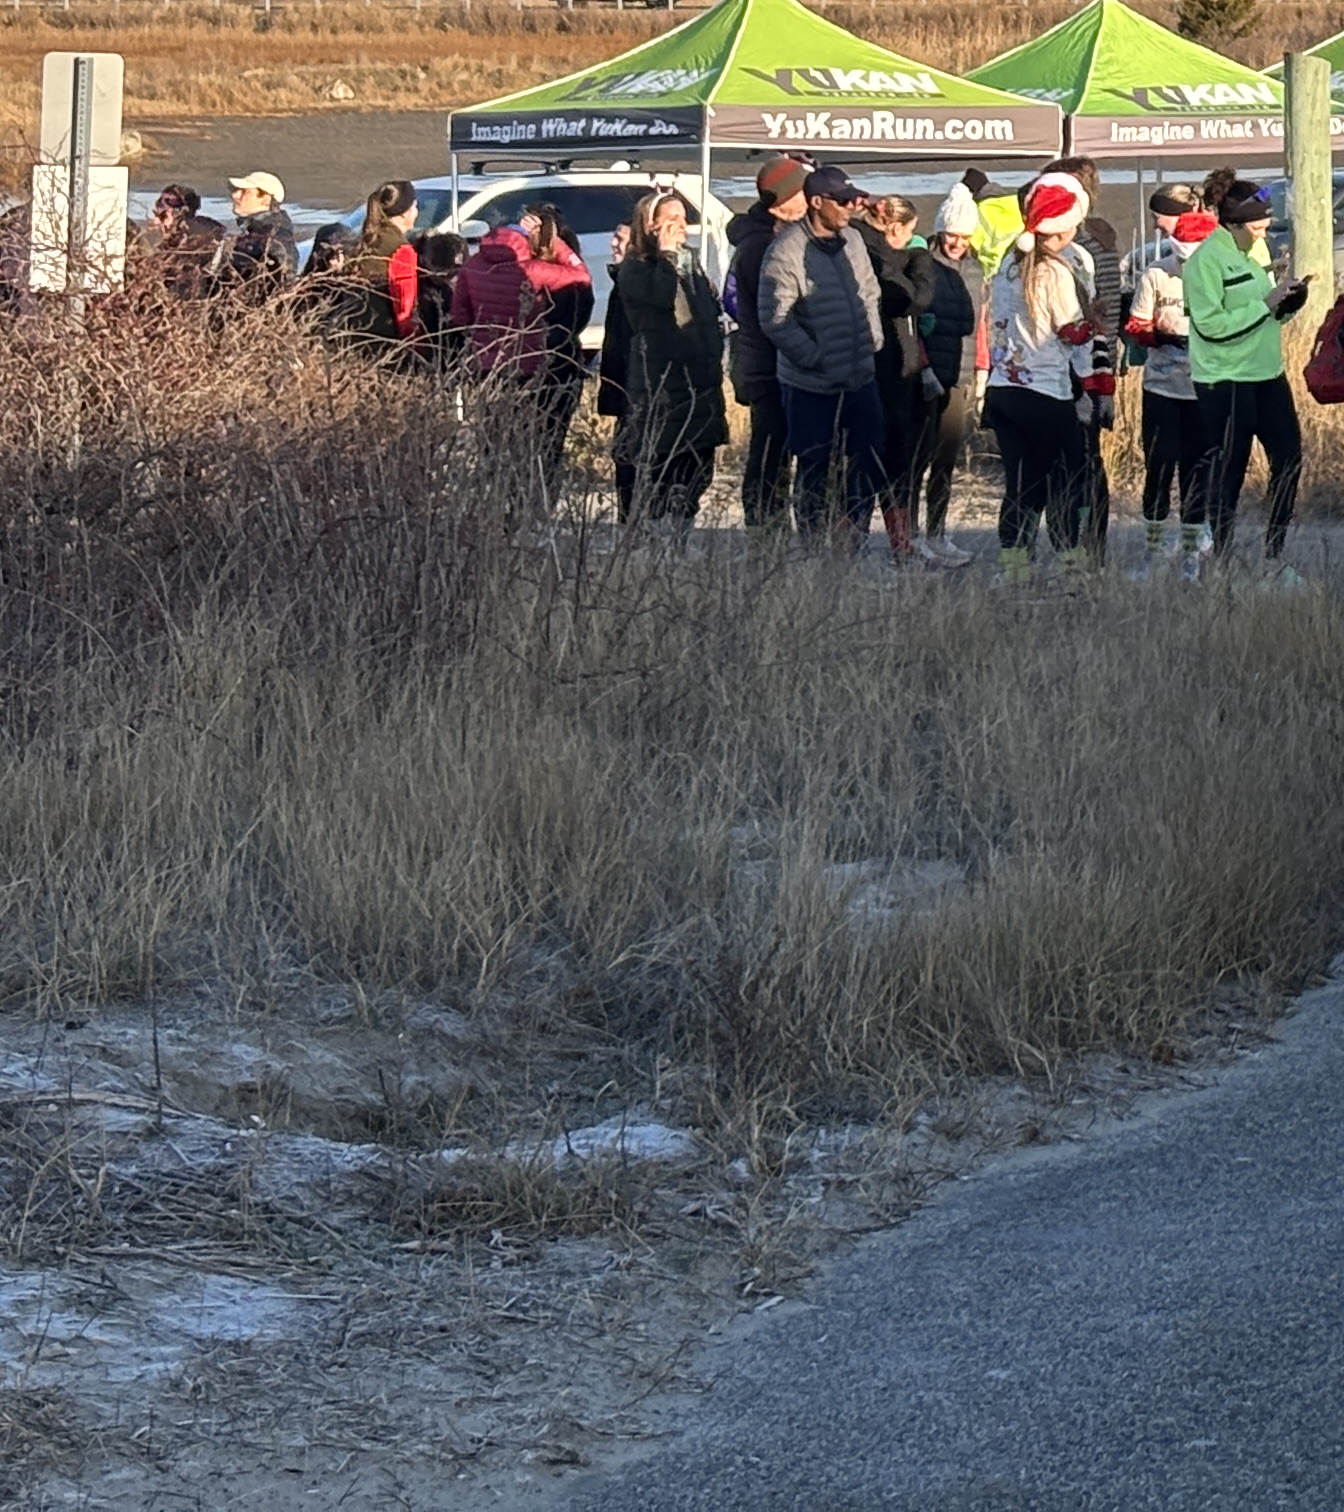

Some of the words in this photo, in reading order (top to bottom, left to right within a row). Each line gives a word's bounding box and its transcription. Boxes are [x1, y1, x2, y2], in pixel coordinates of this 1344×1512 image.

[738, 66, 942, 96] YUKAN
[1101, 83, 1278, 111] YUKAN
[471, 121, 536, 144] Imagine
[541, 117, 586, 139] What
[762, 111, 1014, 141] YuKanRun.com
[1111, 120, 1194, 145] Imagine
[1200, 118, 1254, 140] What
